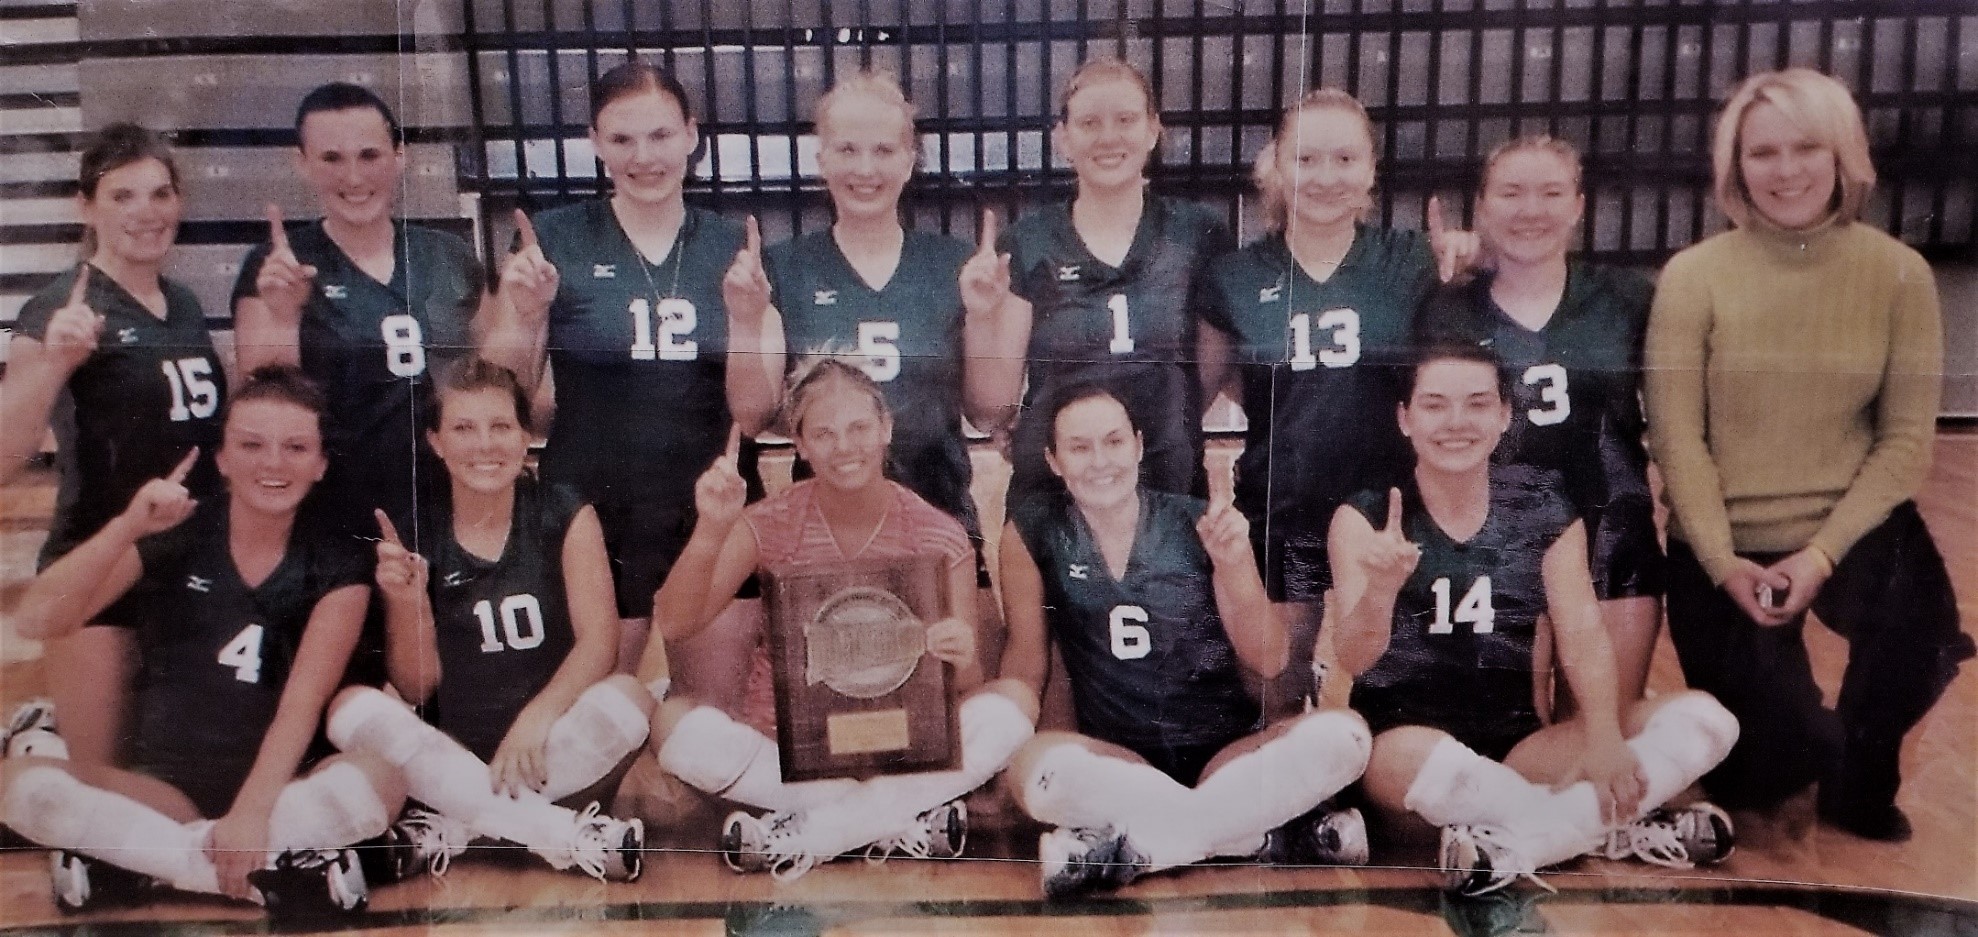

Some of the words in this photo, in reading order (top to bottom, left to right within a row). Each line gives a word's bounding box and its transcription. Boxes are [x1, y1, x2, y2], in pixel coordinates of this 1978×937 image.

[381, 314, 426, 377] 8
[629, 298, 698, 360] 12
[857, 321, 901, 381] 5
[1107, 294, 1134, 352] 1
[1290, 308, 1361, 371] 13
[162, 357, 217, 421] 15
[1523, 363, 1570, 426] 3
[473, 593, 545, 652] 10
[1109, 605, 1151, 660] 6
[1429, 575, 1495, 633] 14
[218, 624, 263, 683] 4
